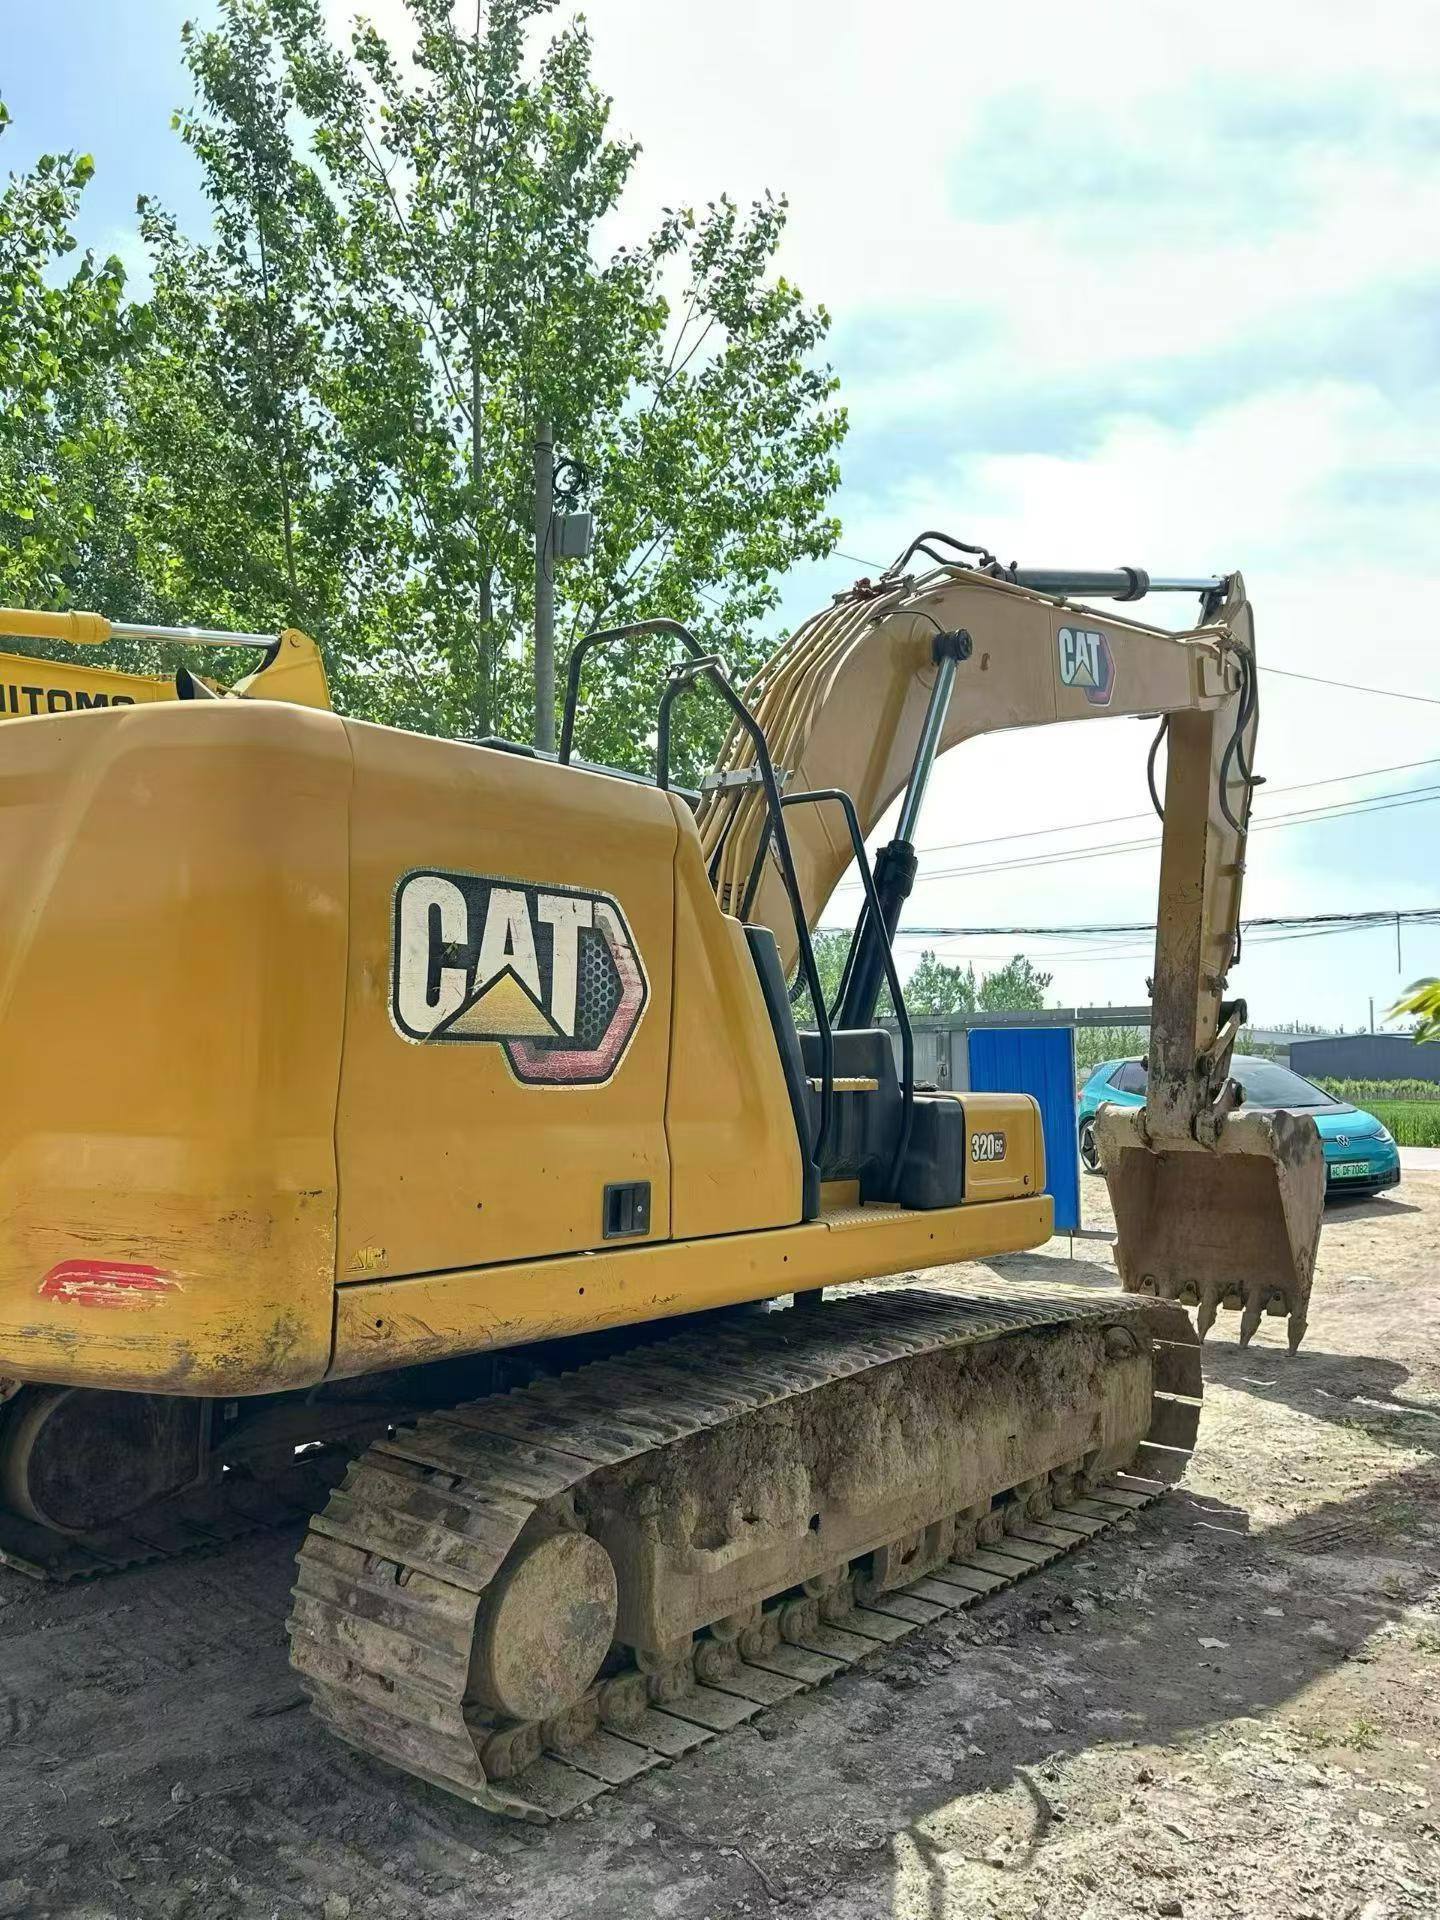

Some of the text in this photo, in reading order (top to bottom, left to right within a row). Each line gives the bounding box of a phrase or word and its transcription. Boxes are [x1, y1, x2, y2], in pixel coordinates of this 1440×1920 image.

[1059, 628, 1100, 687] CAT
[398, 876, 593, 1036] CAT
[972, 1134, 995, 1161] 320
